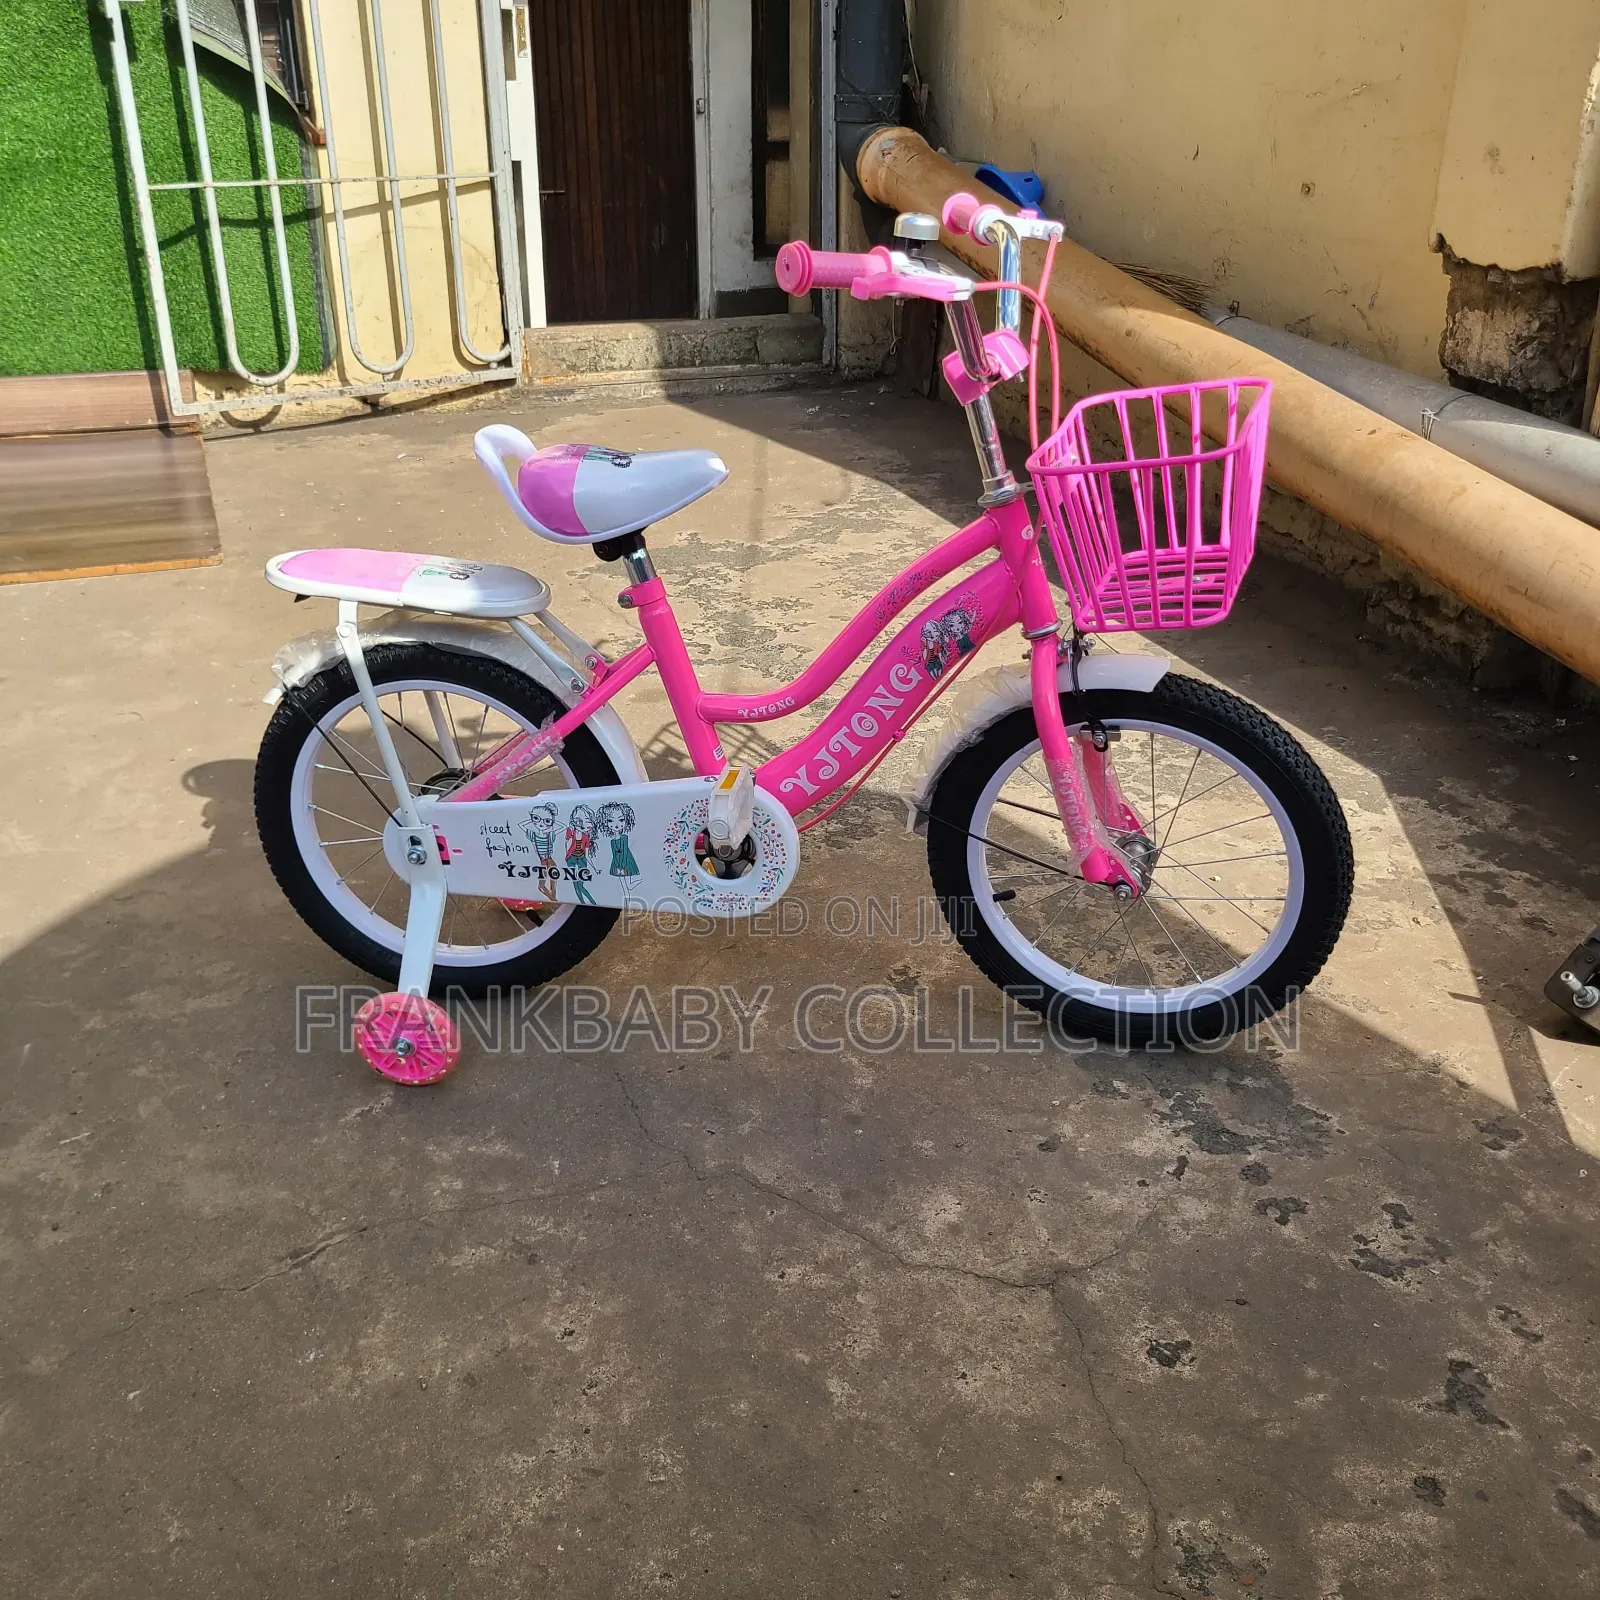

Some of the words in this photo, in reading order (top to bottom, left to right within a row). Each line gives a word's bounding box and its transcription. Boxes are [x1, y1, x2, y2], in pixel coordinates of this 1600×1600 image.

[738, 696, 796, 719] YJTONG
[779, 663, 924, 797] YJTONG
[485, 837, 529, 858] fashion
[498, 861, 593, 882] YJTONG
